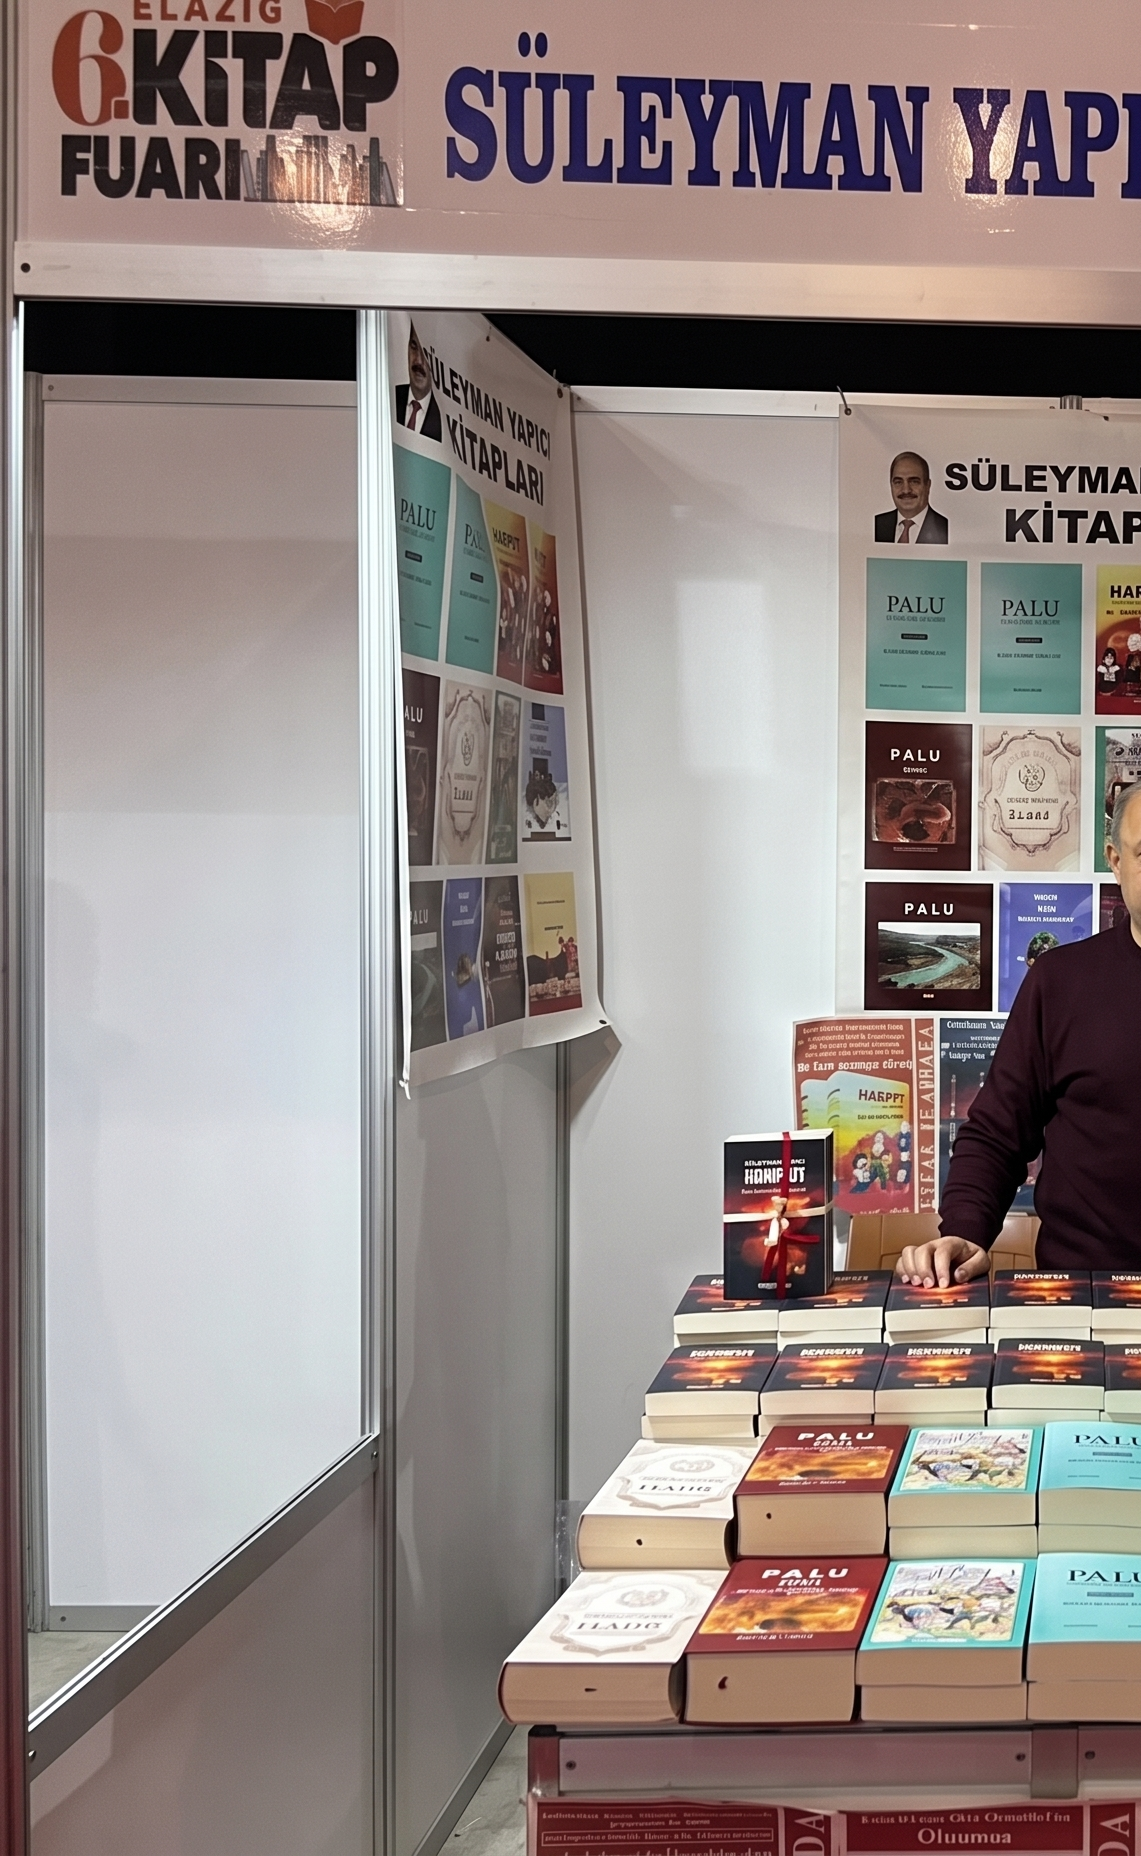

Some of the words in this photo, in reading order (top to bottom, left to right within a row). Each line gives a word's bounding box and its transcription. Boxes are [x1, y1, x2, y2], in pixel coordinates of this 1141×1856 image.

[443, 31, 930, 193] SÜLEYMAN
[61, 134, 241, 200] FUARI
[507, 406, 550, 462] YAPICI
[446, 413, 544, 507] KİTAPLARI
[400, 498, 437, 531] PALU
[887, 595, 946, 615] PALU
[1001, 599, 1061, 618] PALU
[404, 704, 423, 723] ALU
[890, 748, 940, 762] PALU
[904, 902, 954, 916] PALU
[797, 1432, 875, 1441] PALU
[761, 1567, 849, 1579] PALU
